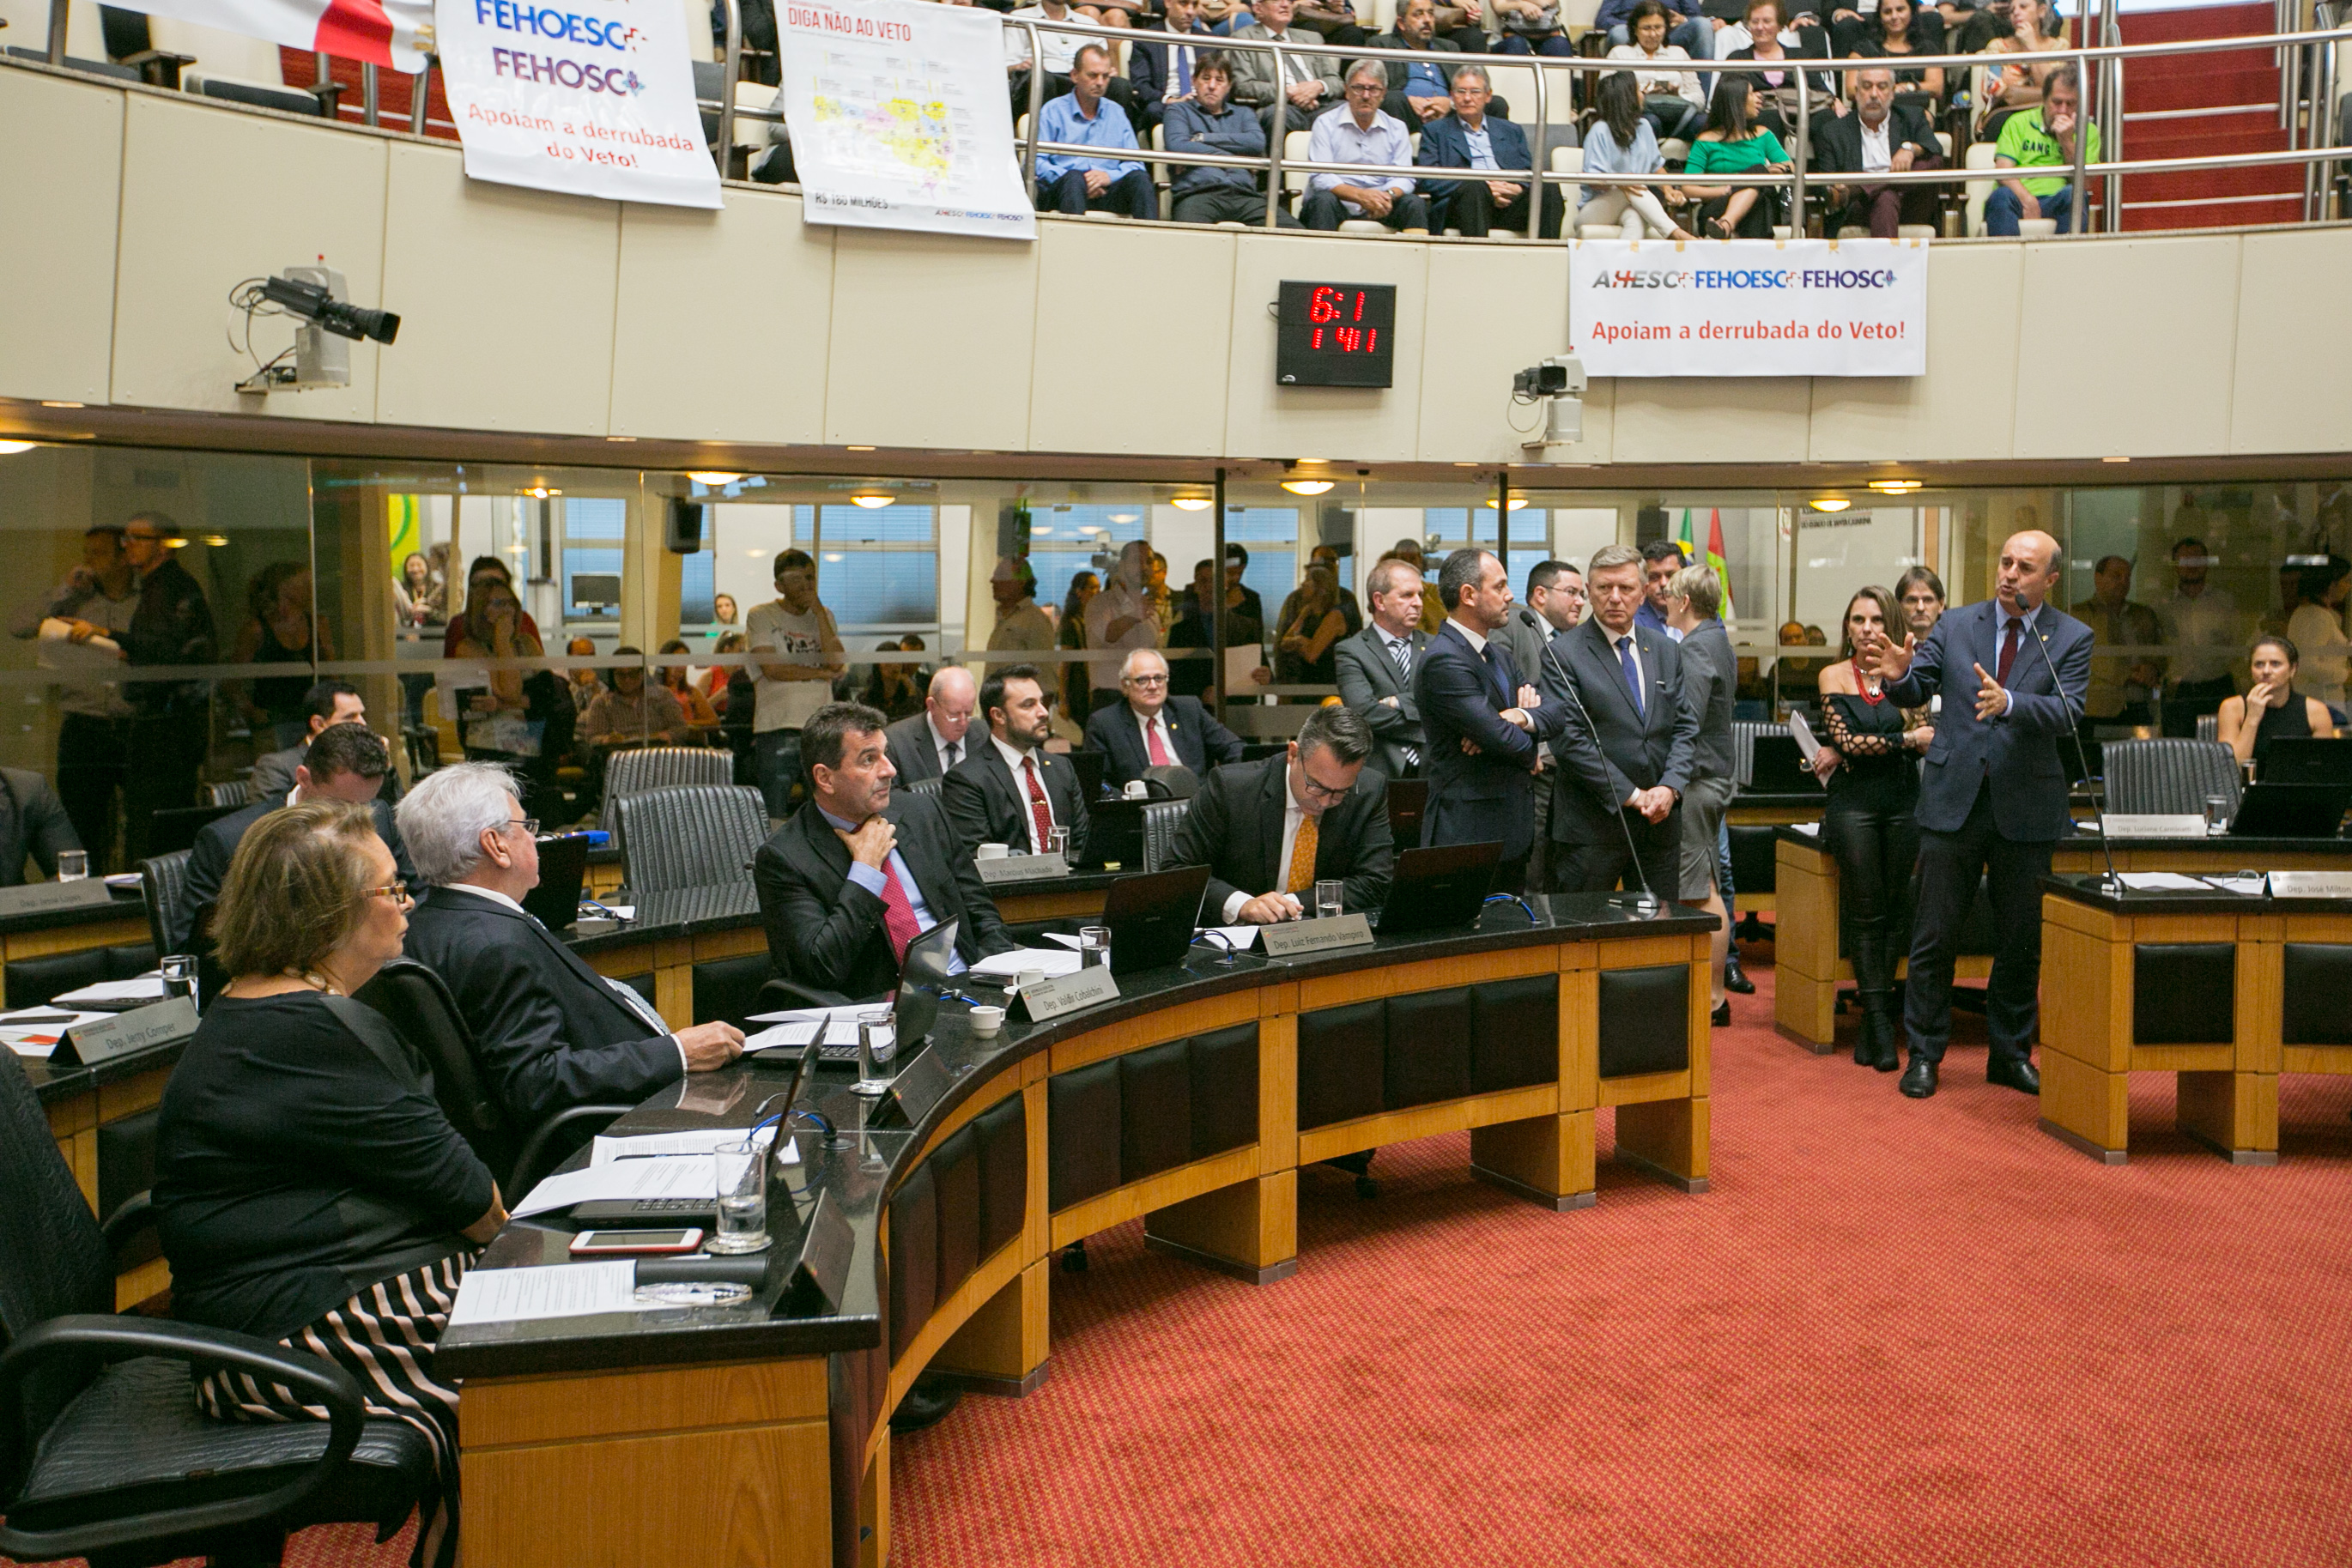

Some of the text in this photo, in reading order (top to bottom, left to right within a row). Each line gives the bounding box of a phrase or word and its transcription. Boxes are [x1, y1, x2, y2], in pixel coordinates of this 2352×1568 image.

[476, 0, 625, 51] FEHOESC
[789, 8, 821, 28] DIGA
[824, 11, 852, 33] NÃO
[856, 19, 874, 36] AO
[876, 21, 912, 41] VETO
[493, 47, 627, 96] FEHOSC
[469, 103, 694, 151] Apoiam a derrubada
[547, 142, 639, 168] do Veto!
[1592, 269, 1884, 288] AHESC FEHOESC FEHOSC
[1592, 320, 1906, 344] Apoiam a derrubada do Veto!
[984, 870, 999, 879] Dep.
[2288, 885, 2306, 894] Dep.
[2307, 884, 2324, 893] José
[1274, 929, 1364, 951] Dep. Luiz Fernando Vampiro
[1043, 984, 1105, 1012] Dep. Valdir Cobalchini
[106, 1038, 126, 1050] Dep.
[127, 1031, 146, 1045] Jerry
[145, 1022, 176, 1039] Comper
